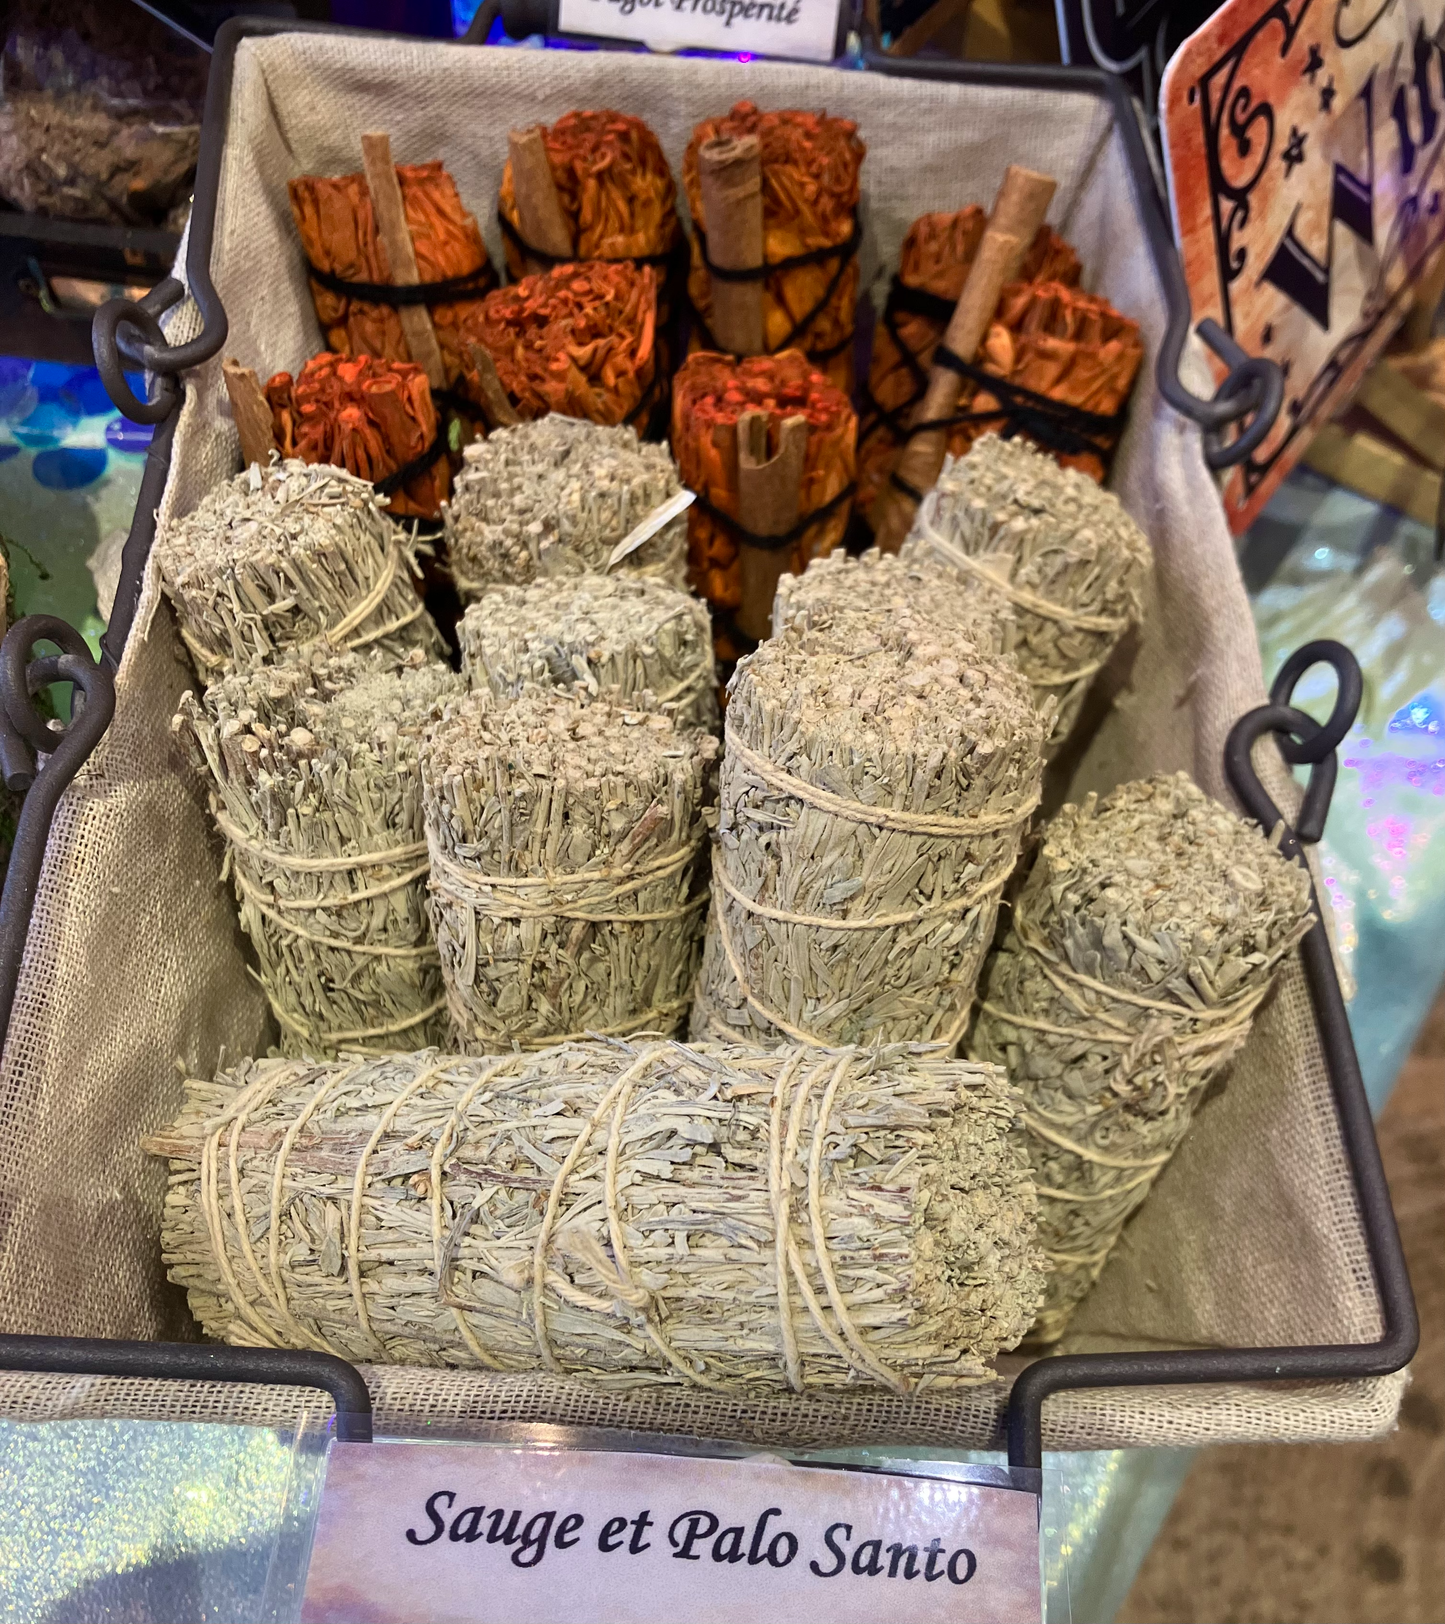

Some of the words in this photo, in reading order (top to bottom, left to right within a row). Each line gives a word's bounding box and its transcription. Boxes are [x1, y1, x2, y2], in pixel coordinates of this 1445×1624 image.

[406, 1491, 584, 1568] Sauge
[597, 1509, 654, 1555] et
[667, 1508, 799, 1568] Palo
[809, 1522, 978, 1585] Santo
